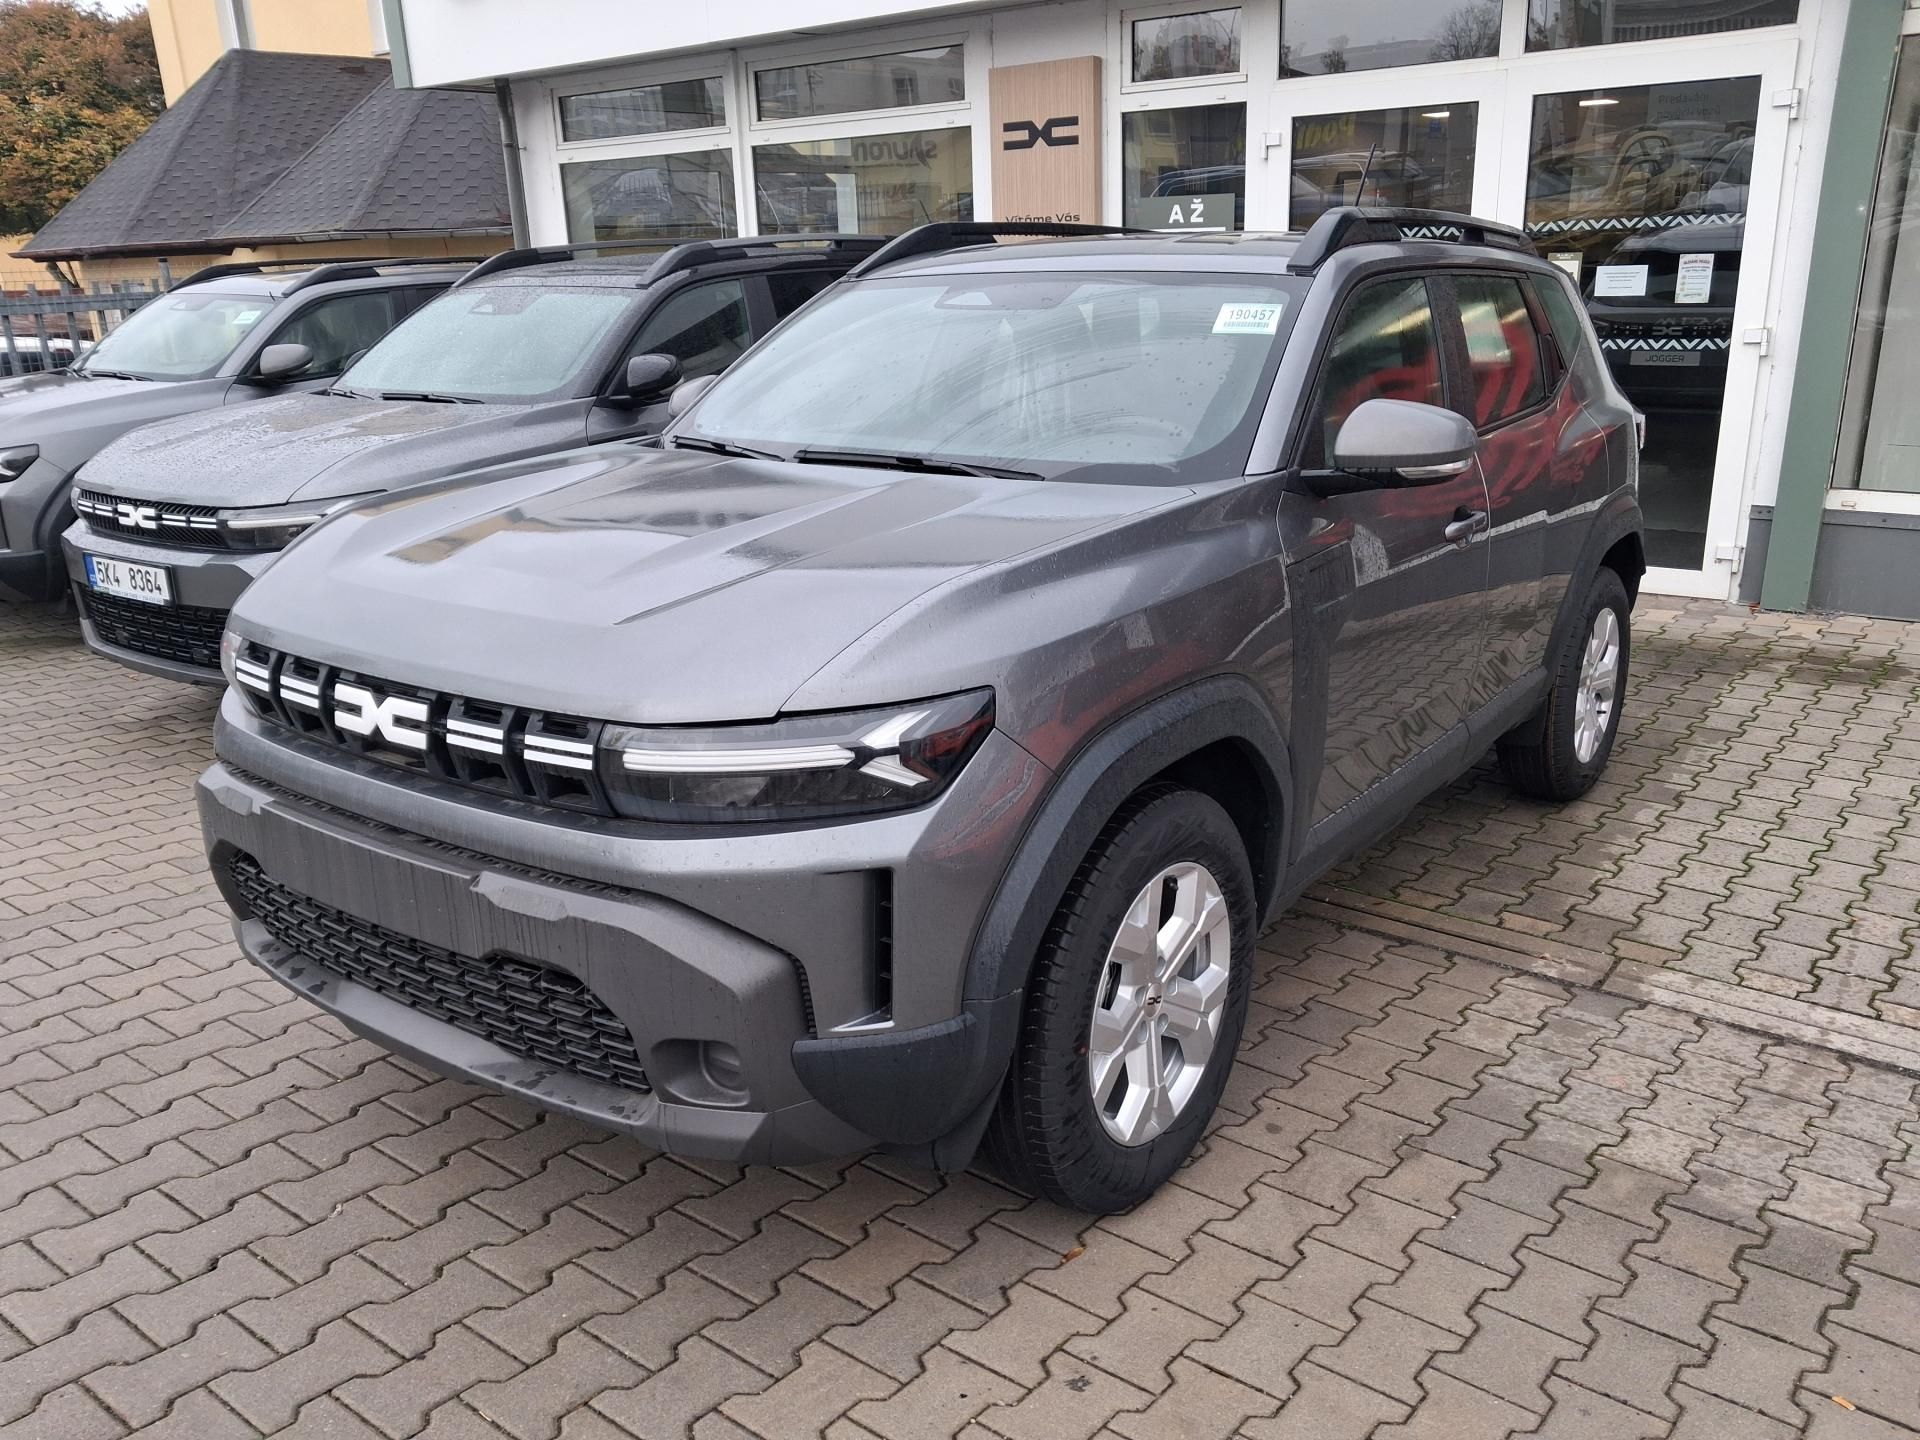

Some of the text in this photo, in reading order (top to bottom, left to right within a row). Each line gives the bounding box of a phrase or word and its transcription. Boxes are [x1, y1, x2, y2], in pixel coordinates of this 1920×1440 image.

[1229, 309, 1275, 320] 190457
[1645, 354, 1685, 362] JOGGER
[96, 560, 120, 587] 5K4
[128, 567, 162, 595] 8364
